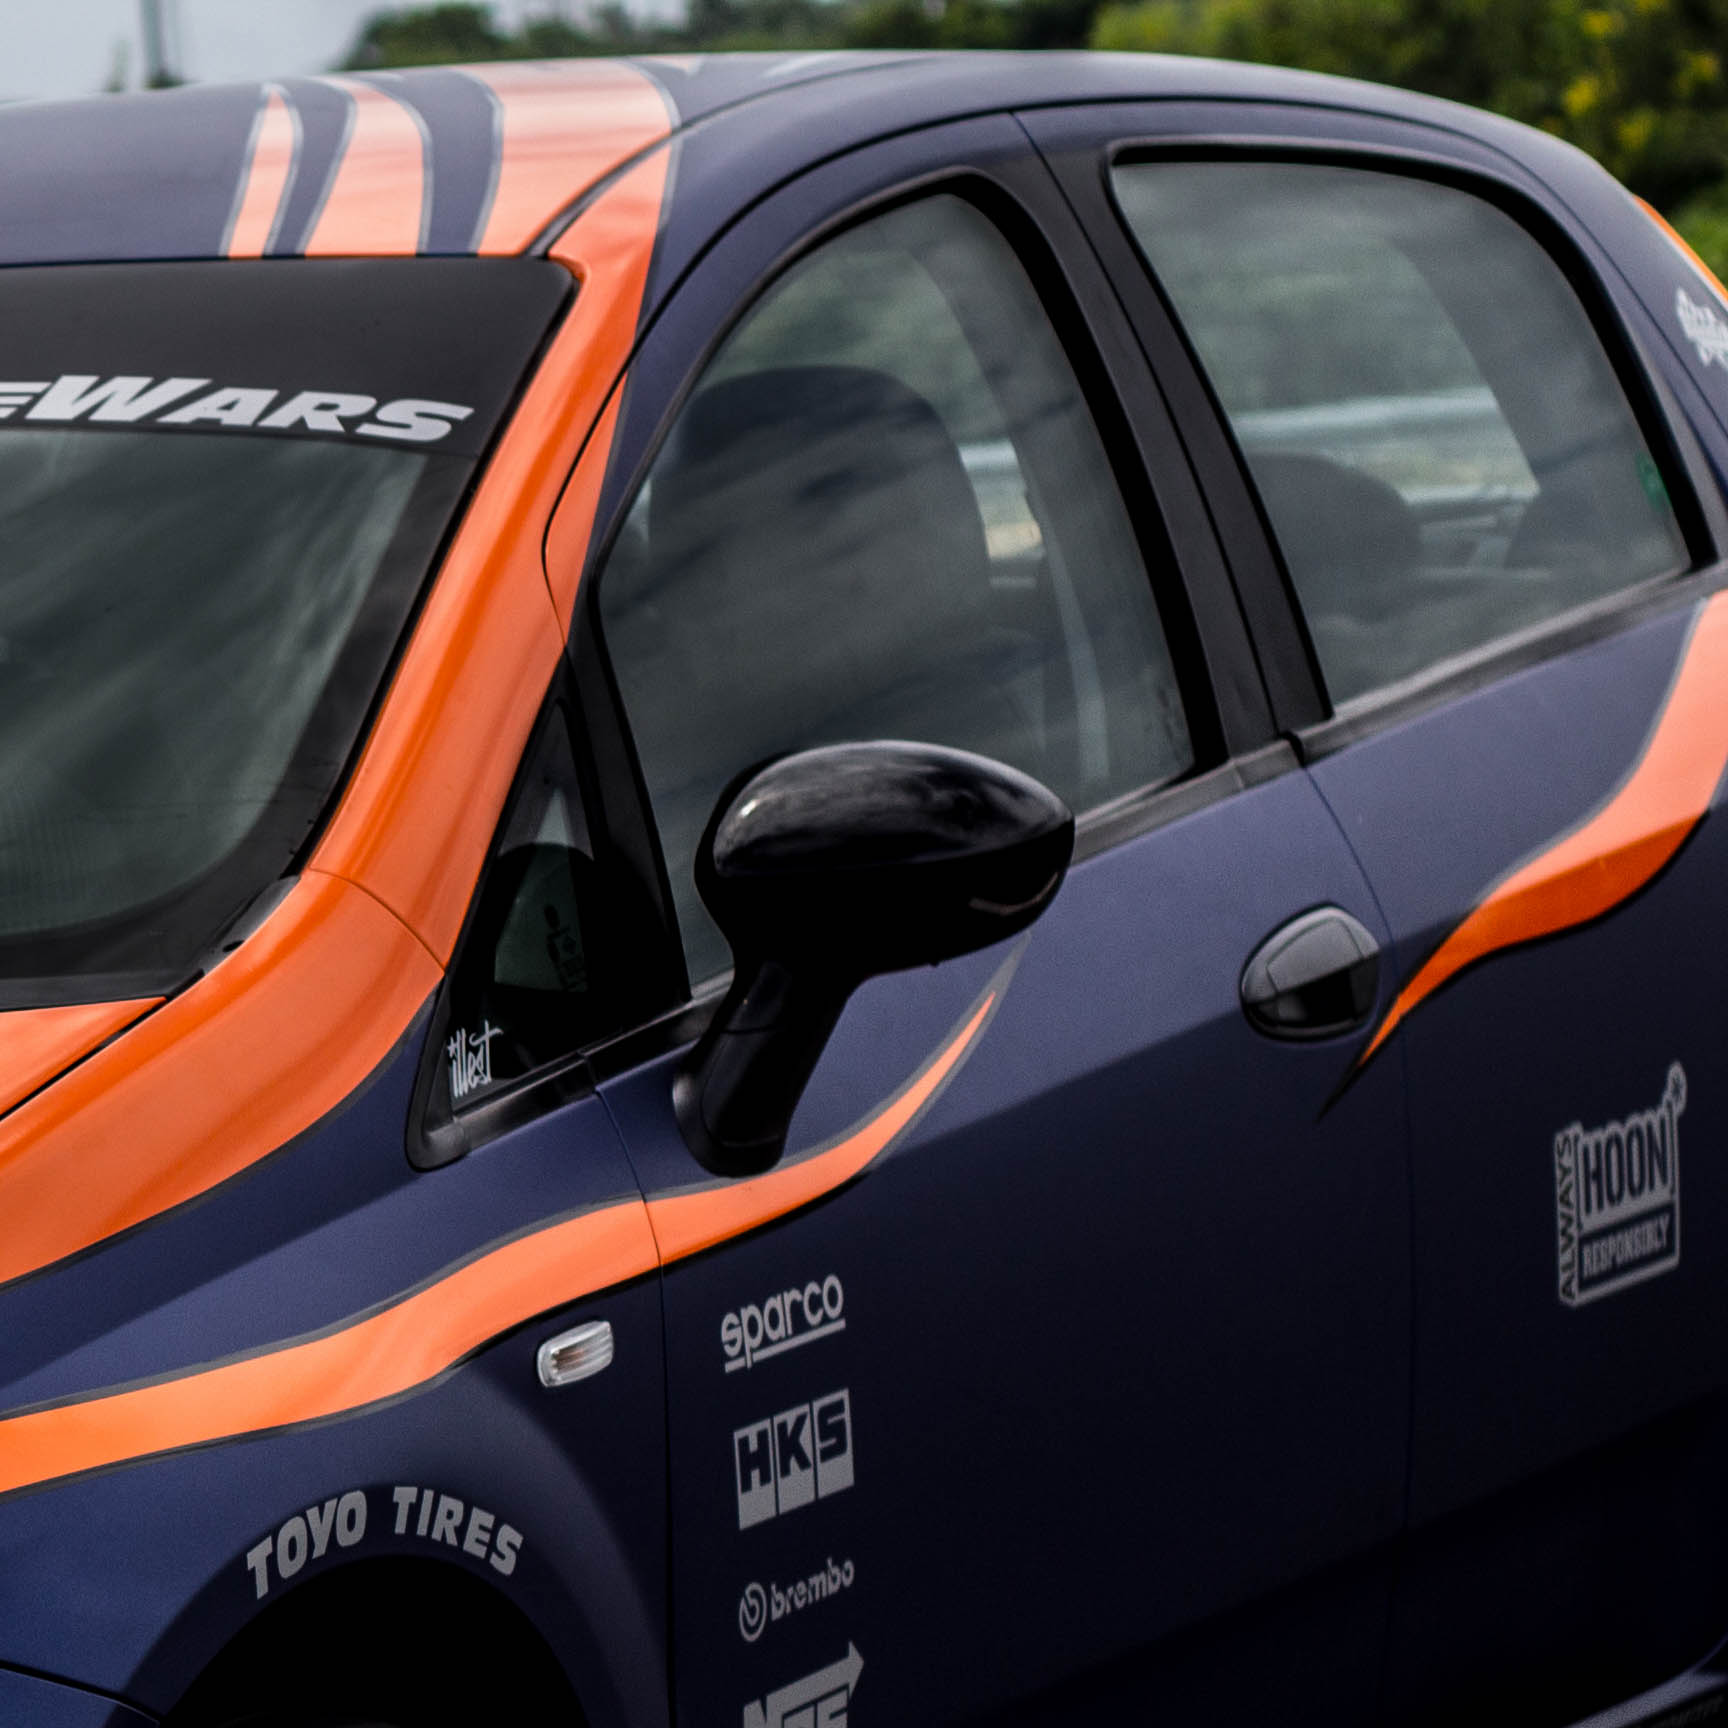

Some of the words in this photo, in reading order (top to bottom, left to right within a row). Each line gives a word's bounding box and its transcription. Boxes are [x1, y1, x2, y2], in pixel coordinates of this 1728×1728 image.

[1582, 1116, 1670, 1214] HOON
[1556, 1133, 1575, 1299] ALWAYS
[720, 1273, 845, 1370] sparco
[737, 1399, 848, 1495] HKS
[246, 1489, 368, 1601] TOYO
[393, 1485, 524, 1577] TIRES
[770, 1555, 856, 1622] brembo
